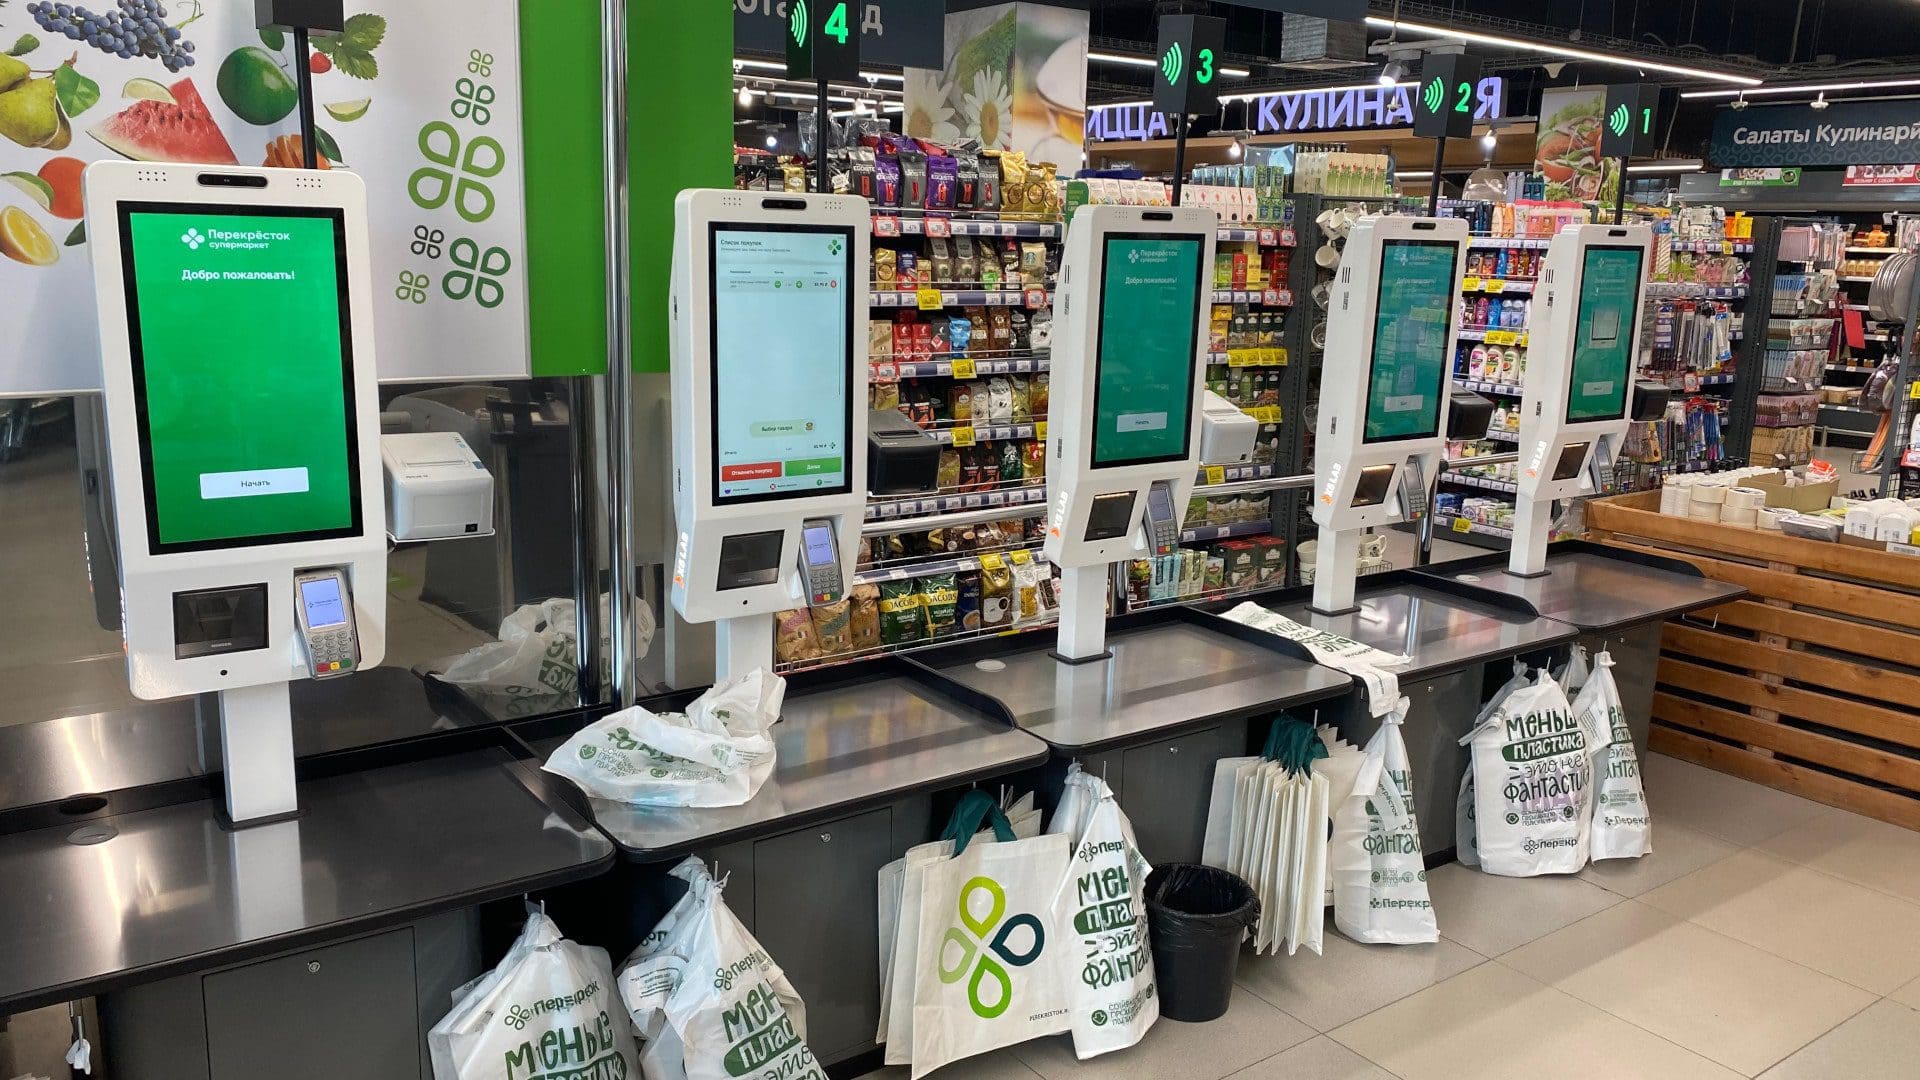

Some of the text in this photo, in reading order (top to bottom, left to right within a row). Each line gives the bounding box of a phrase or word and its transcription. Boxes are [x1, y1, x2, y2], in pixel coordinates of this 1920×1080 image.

[825, 2, 849, 44] 4
[1196, 48, 1214, 84] 3
[1258, 76, 1503, 132] КУЛИНАЯ
[1455, 82, 1472, 113] 2
[1643, 108, 1651, 134] 1
[1733, 127, 1810, 145] Салаты
[208, 229, 290, 242] Перекрёсток
[208, 241, 270, 250] супермаркет
[181, 269, 295, 281] Добро пожаловать!
[240, 480, 271, 488] Начать
